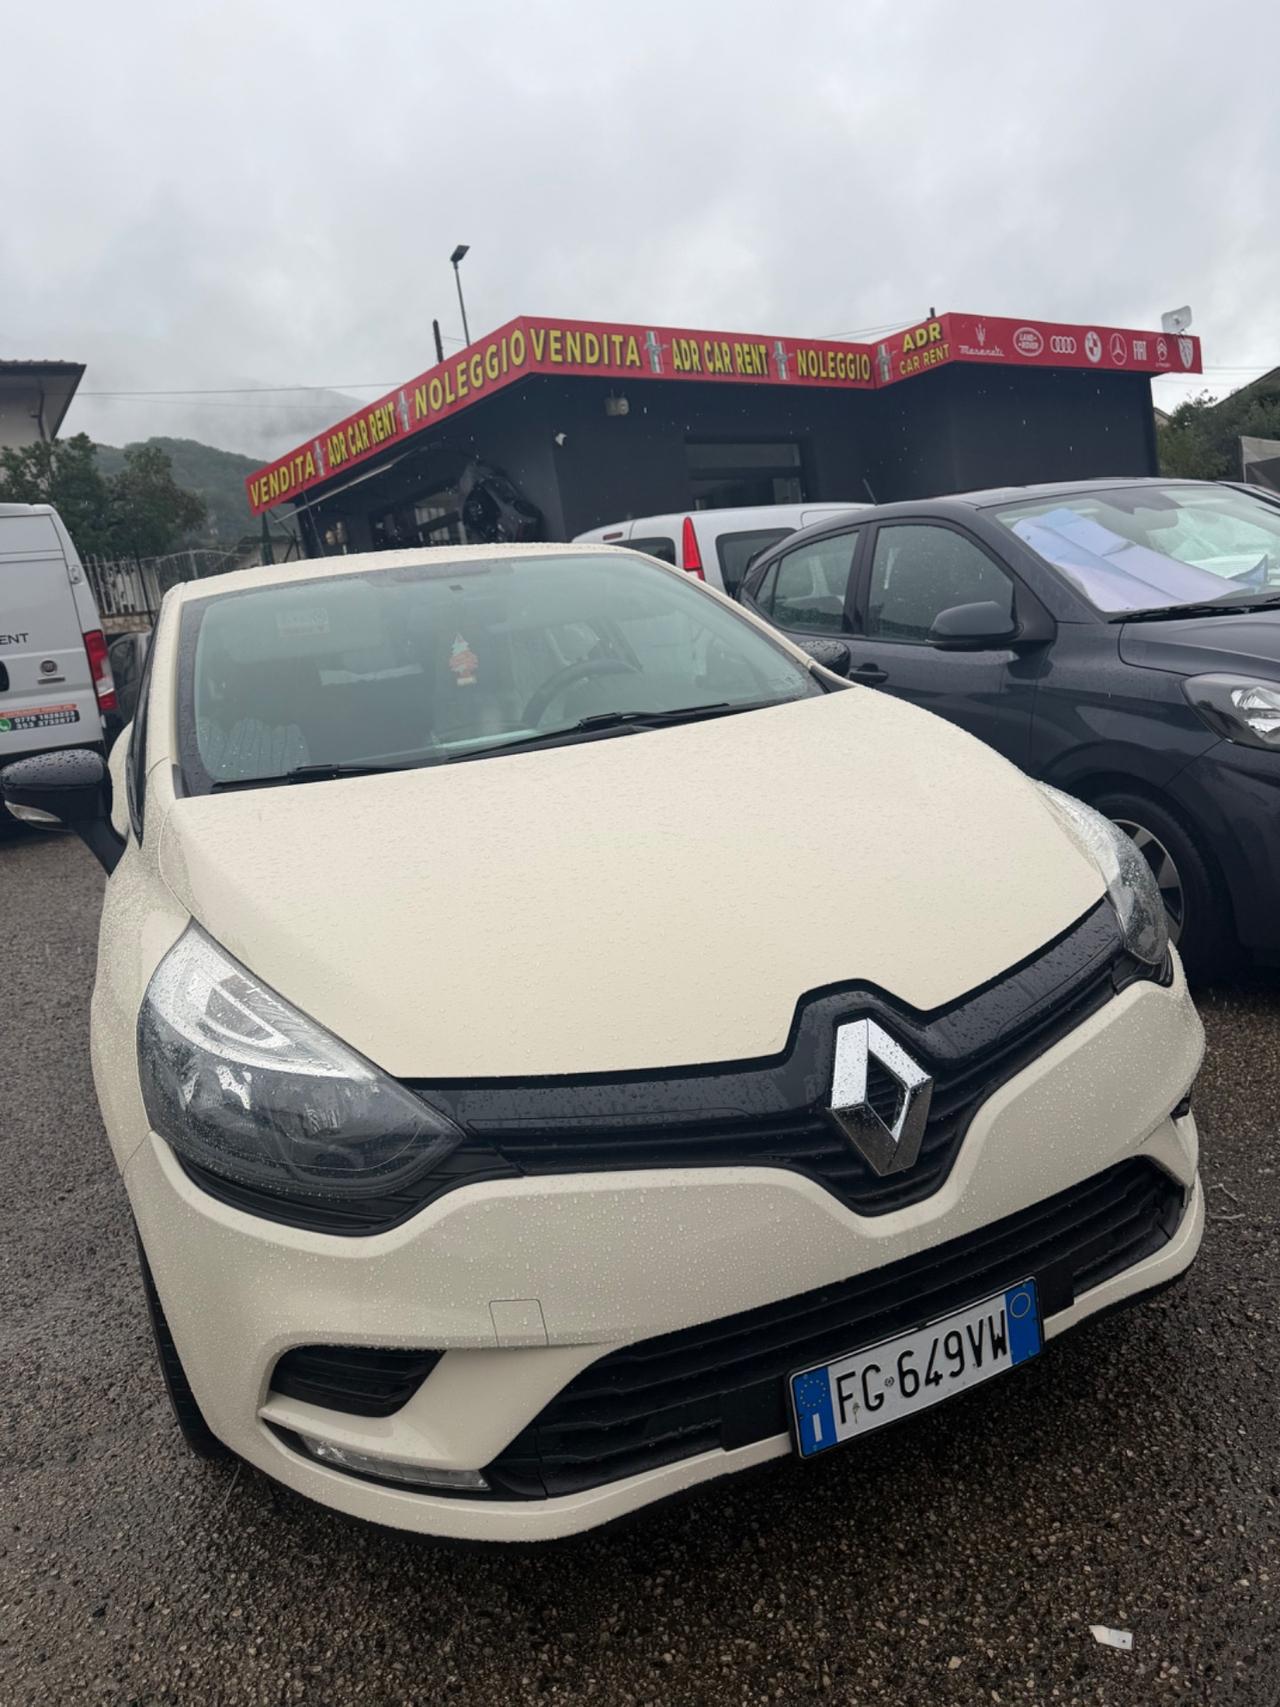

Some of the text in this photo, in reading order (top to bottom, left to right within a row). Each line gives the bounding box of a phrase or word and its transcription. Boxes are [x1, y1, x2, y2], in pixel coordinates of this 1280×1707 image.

[529, 328, 872, 381] VENDITA ADR CAR RENT NOLEGGIO
[902, 322, 942, 353] ADR
[900, 343, 950, 376] CAR RENT
[250, 329, 526, 507] VENDITA ADR CAR RENT NOLEGGIO
